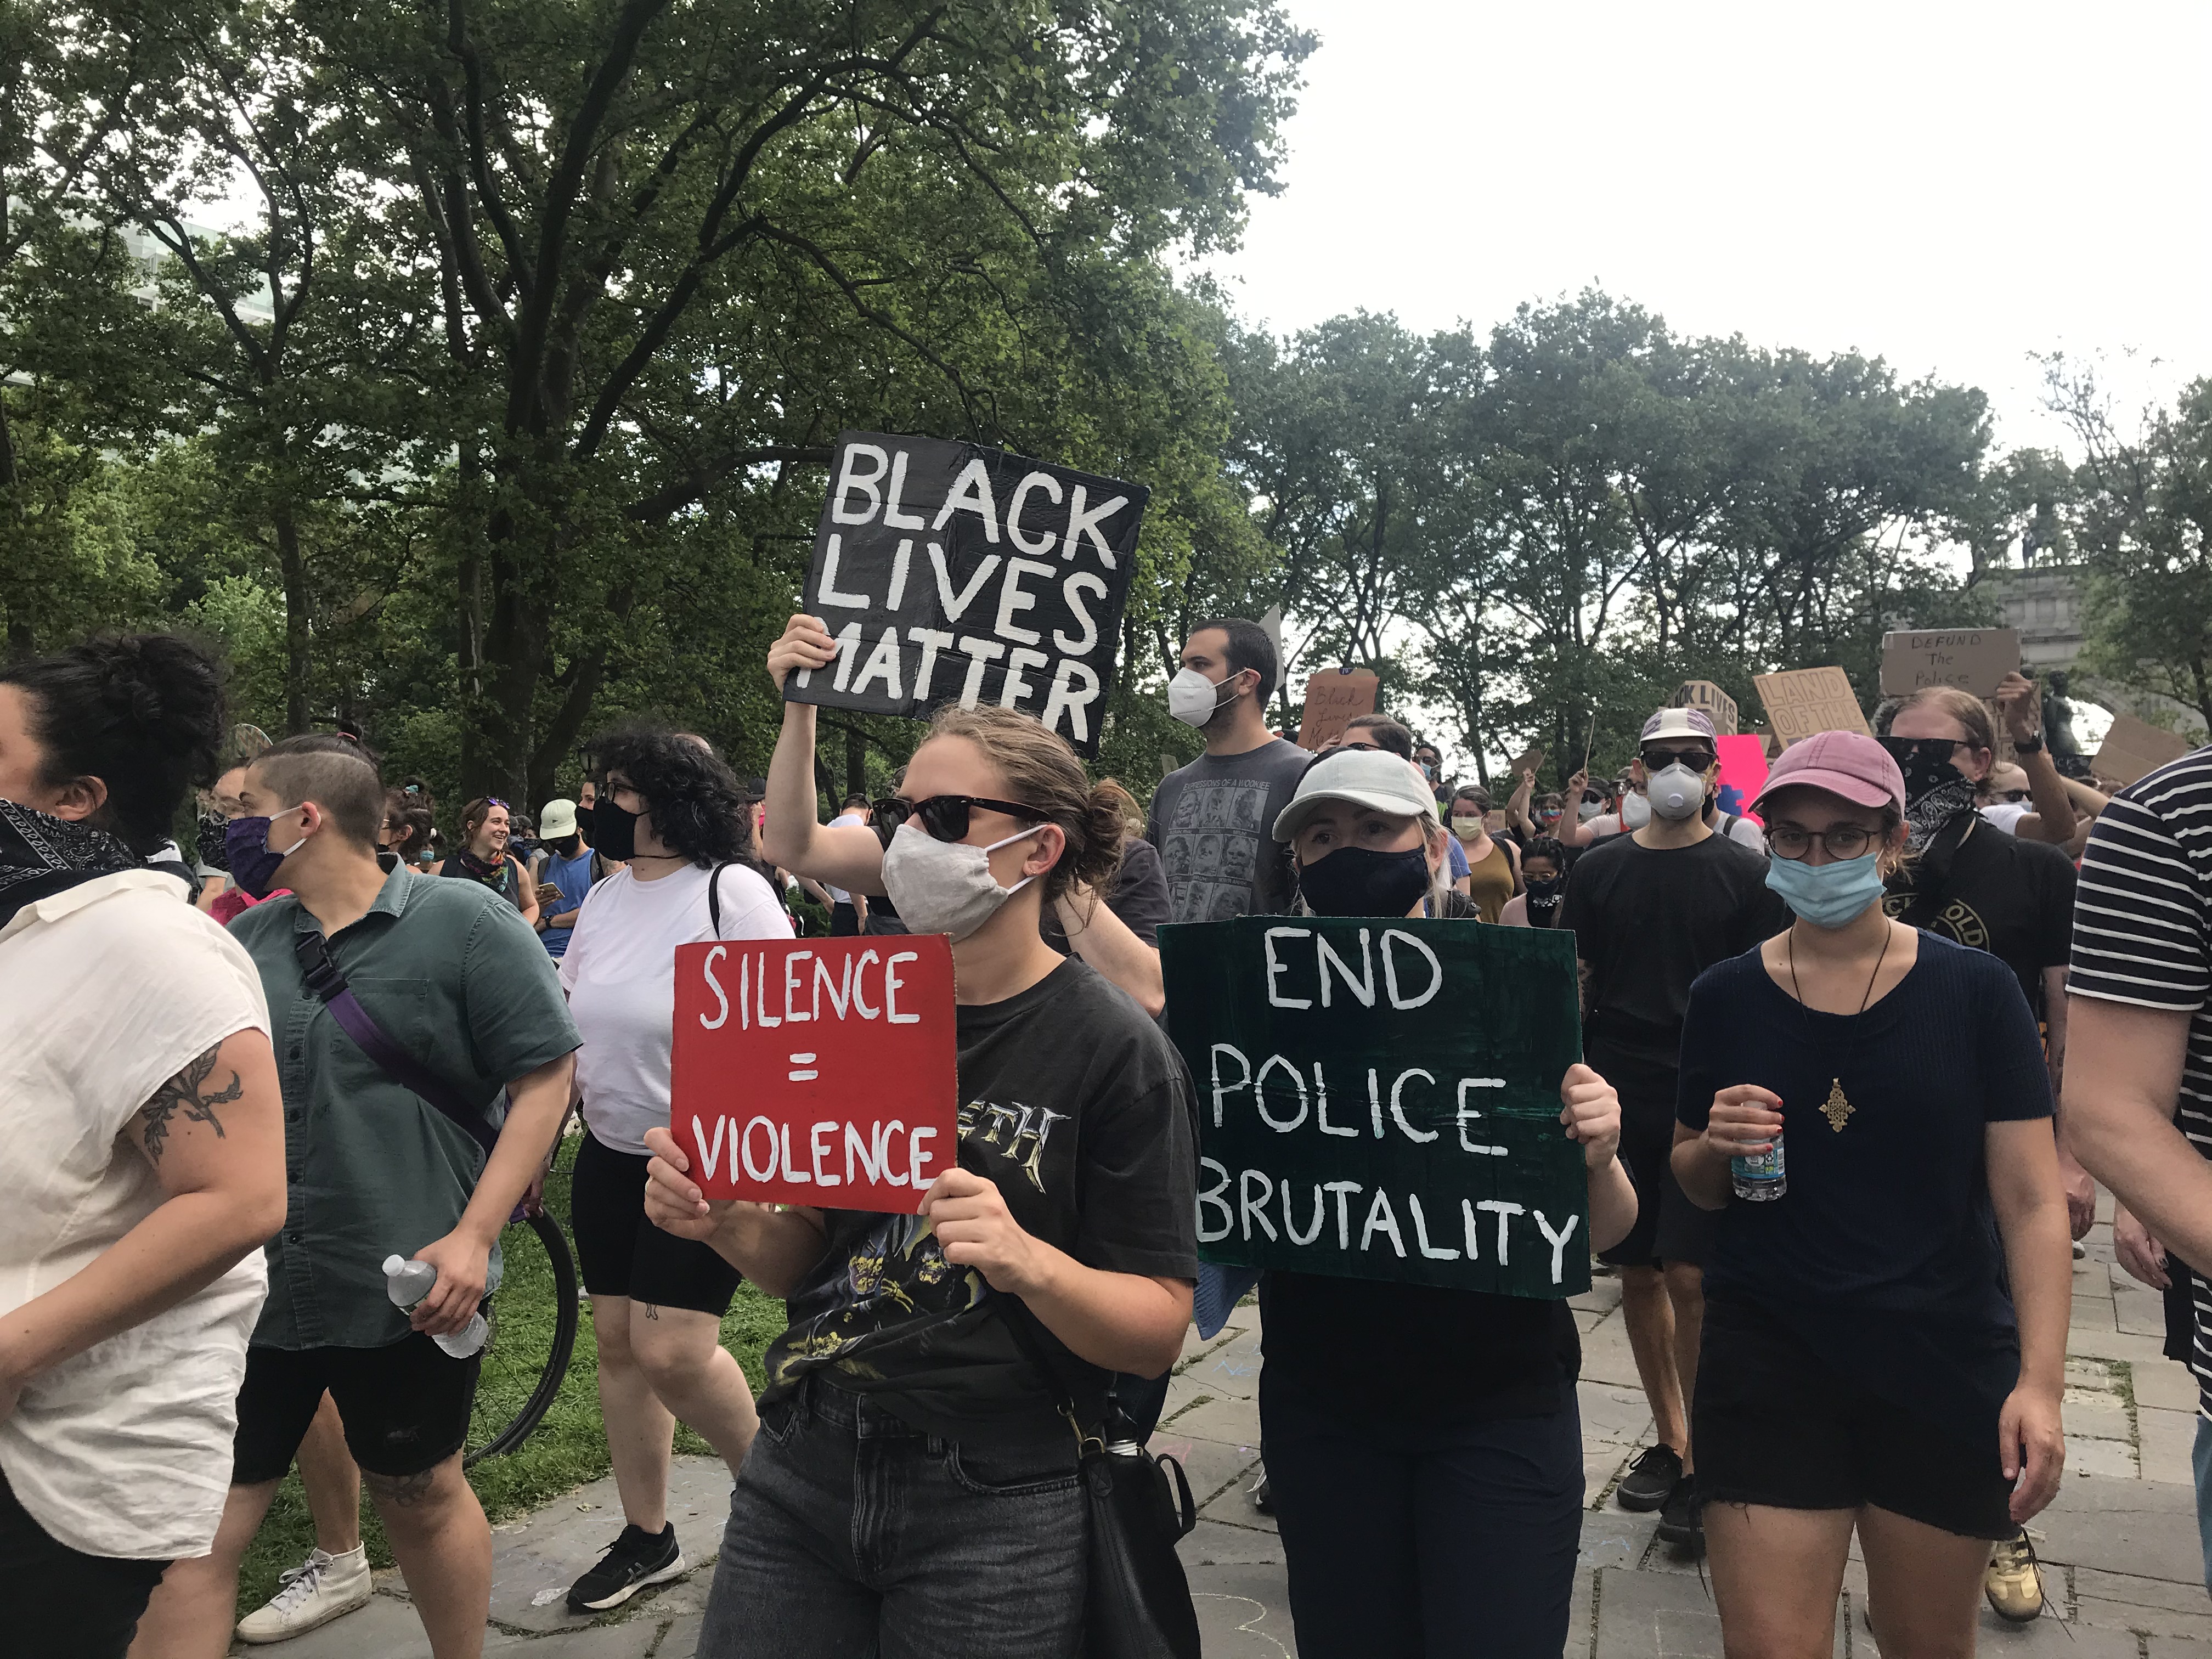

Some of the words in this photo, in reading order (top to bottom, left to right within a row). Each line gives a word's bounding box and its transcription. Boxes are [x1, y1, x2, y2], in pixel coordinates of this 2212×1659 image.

[832, 443, 1129, 569] BLACK
[818, 534, 1109, 656] LIVES
[1912, 634, 1982, 650] DEFUND
[1925, 652, 1954, 666] The
[797, 617, 1101, 742] MATTER
[1314, 686, 1364, 706] Black
[1758, 671, 1846, 708] LAND
[1916, 670, 1970, 686] Police
[1700, 685, 1735, 724] LIVES
[1774, 704, 1810, 736] OF
[1809, 699, 1865, 730] THE
[1183, 780, 1221, 791] EXPRESSIONS
[1221, 778, 1232, 787] OF
[1239, 780, 1271, 790] WOOKIEE
[700, 945, 921, 1030] SILENCE
[1264, 926, 1443, 1010] END
[788, 1053, 819, 1081] =
[1211, 1043, 1508, 1156] POLICE
[692, 1114, 938, 1190] VIOLENCE
[1195, 1156, 1579, 1285] BRUTALITY
